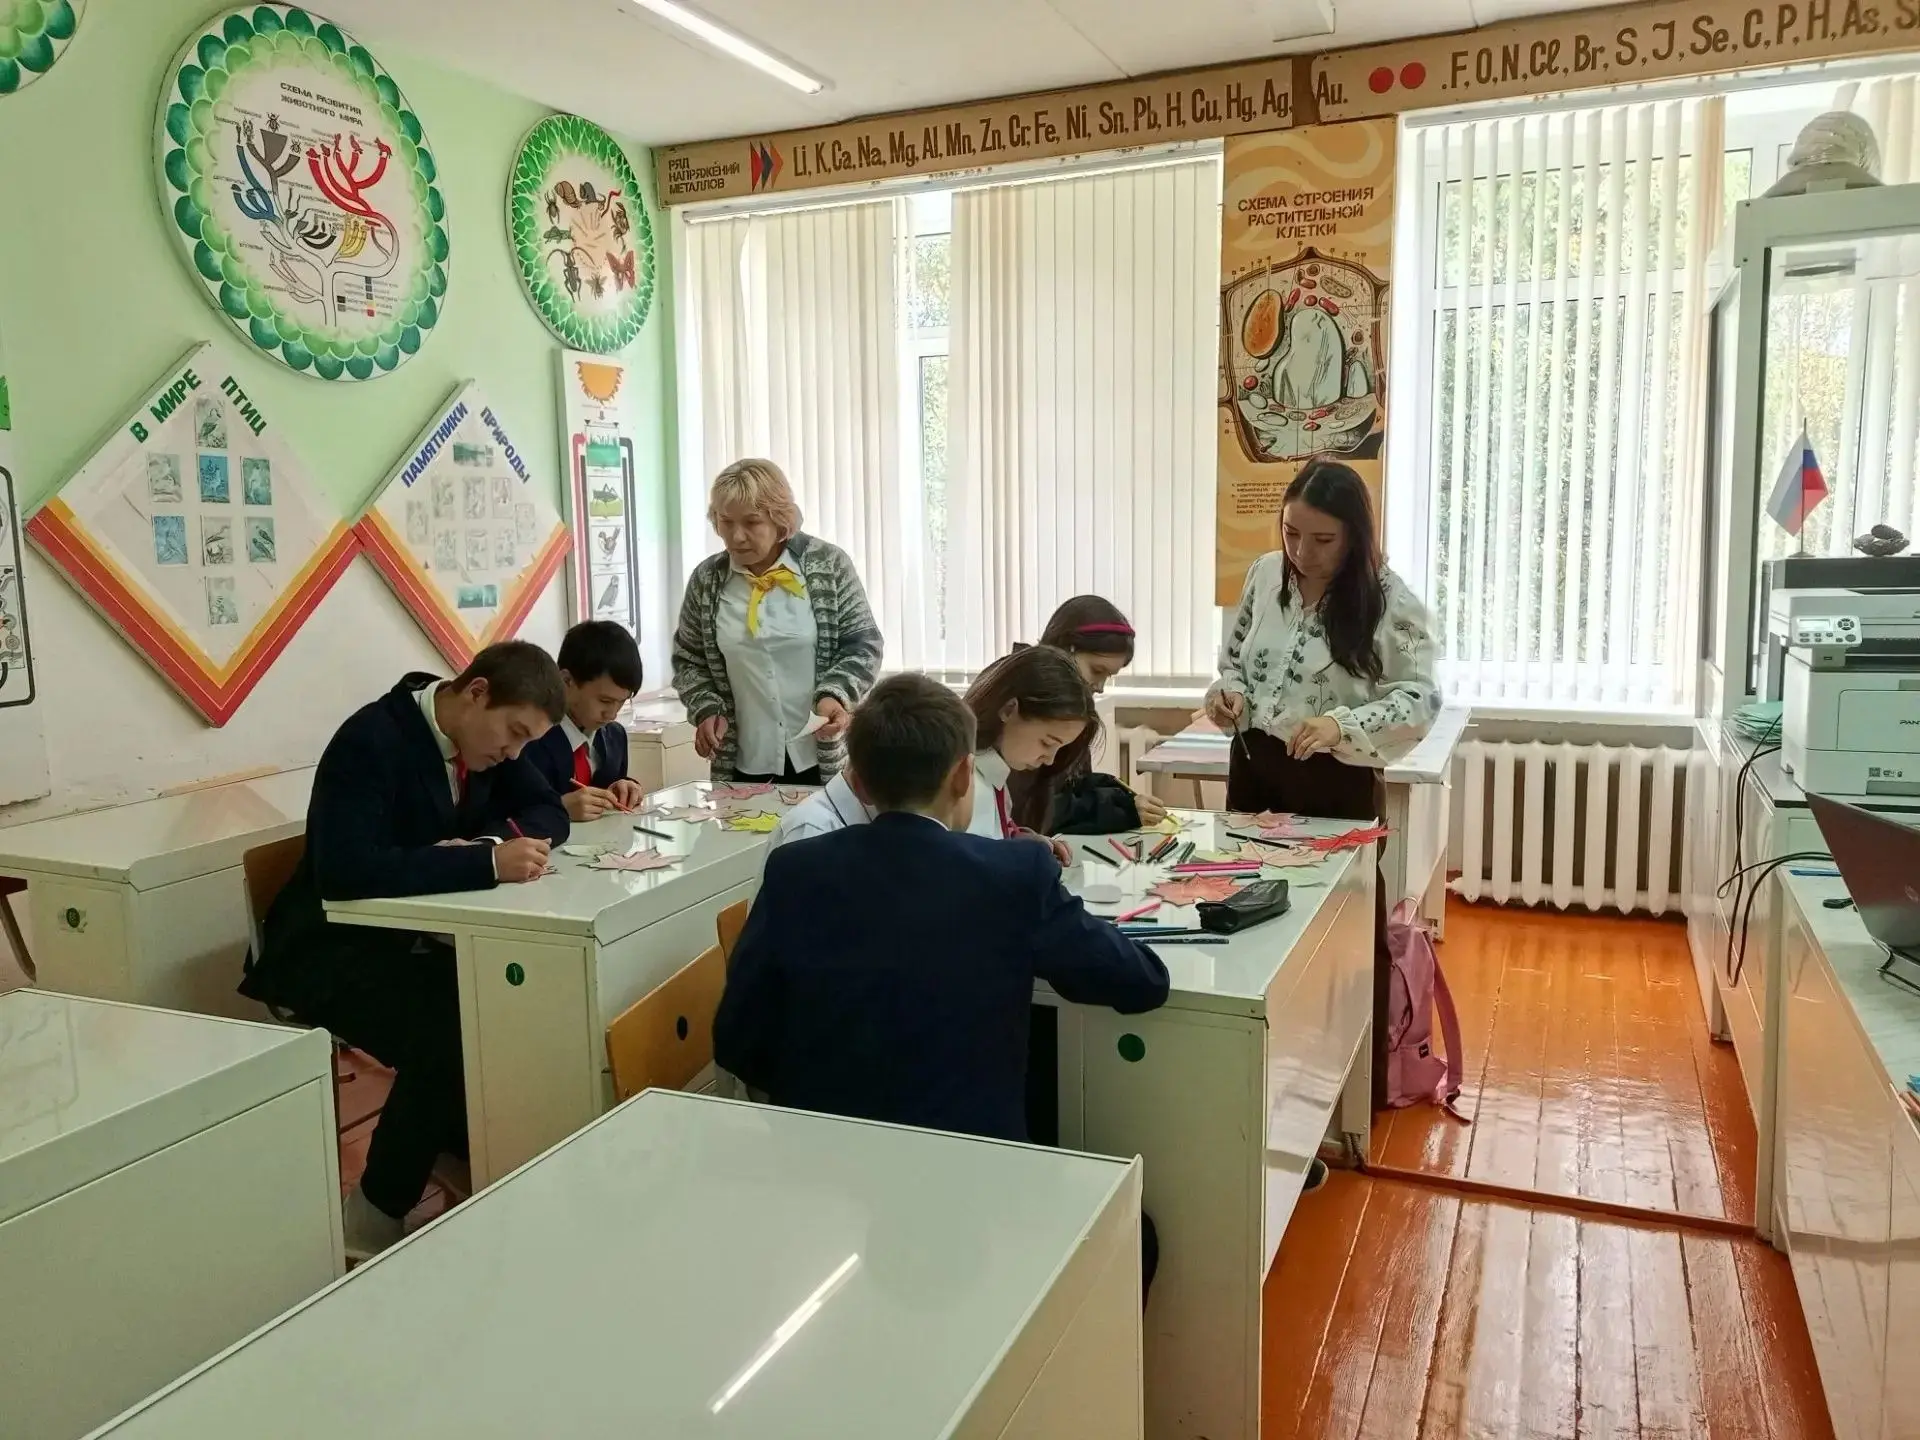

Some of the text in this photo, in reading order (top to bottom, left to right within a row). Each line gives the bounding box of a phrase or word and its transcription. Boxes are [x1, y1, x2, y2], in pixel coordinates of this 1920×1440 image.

[1894, 0, 1920, 30] S
[280, 82, 362, 116] СХЕМА РАЗВИТИЯ
[281, 94, 336, 117] ЖИВОТНОГО
[339, 113, 363, 127] МИРА
[668, 156, 690, 171] РЯД
[669, 160, 740, 182] НАПРЯЖЕНИЙ
[669, 178, 725, 194] МЕТАЛЛОВ
[1238, 186, 1374, 212] СХЕМА СТРОЕНИЯ
[1248, 203, 1364, 227] РАСТИТЕЛЬНОЙ
[1276, 223, 1337, 239] КЛЕТКИ
[129, 368, 267, 443] В МИРЕ ПТИЦ
[400, 401, 531, 488] ПАМЯТНИКИ ПРИРОДЫ
